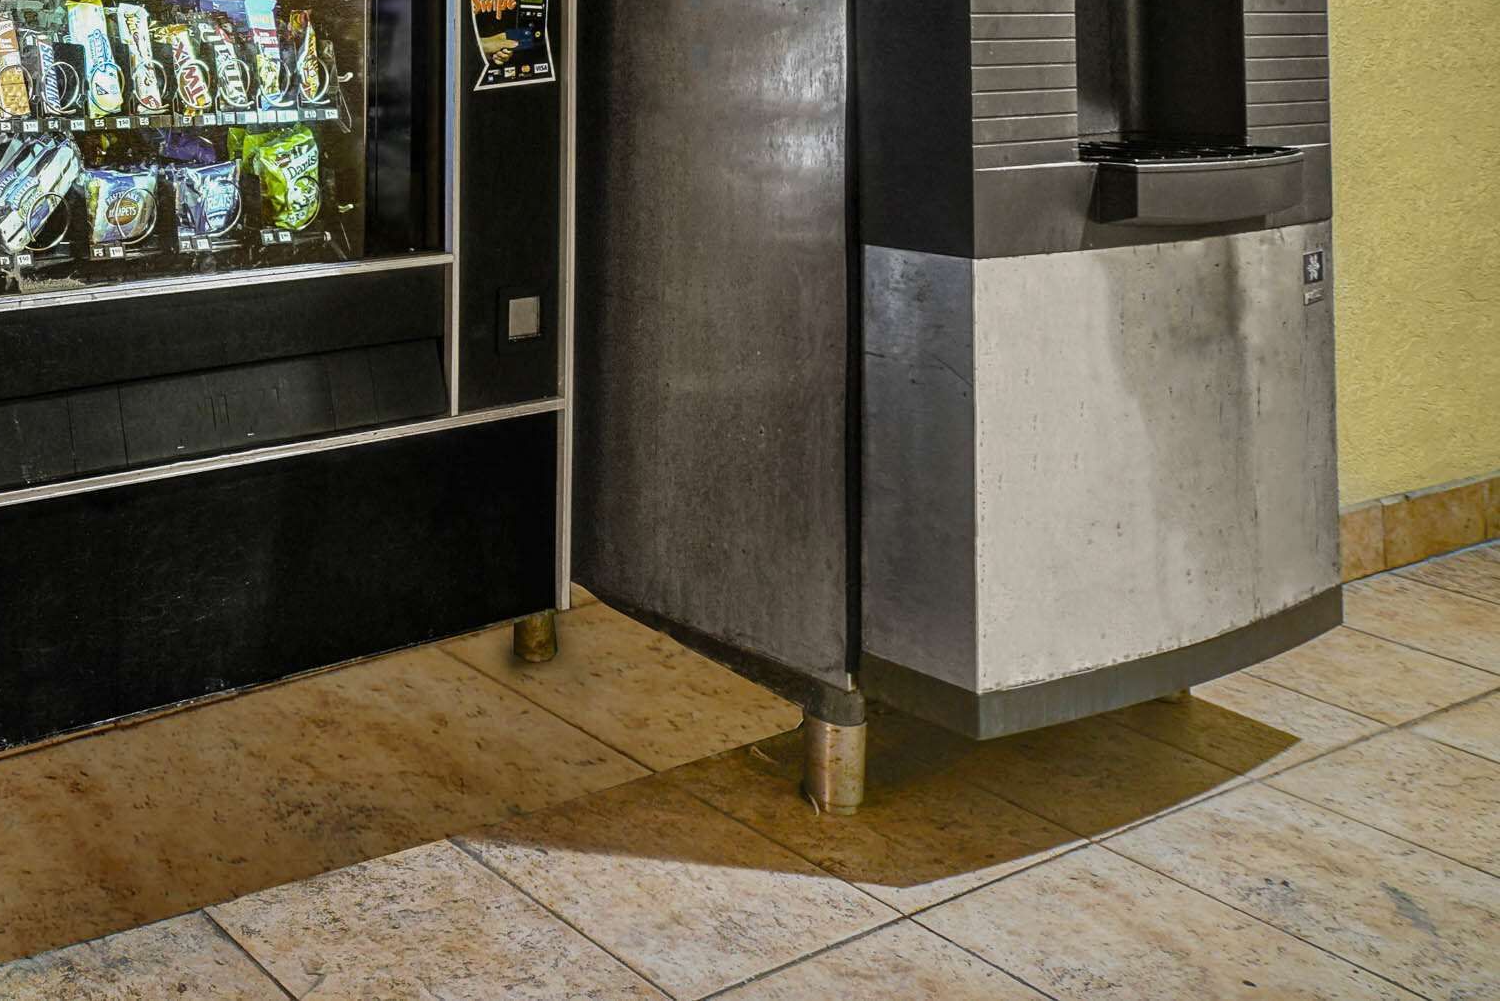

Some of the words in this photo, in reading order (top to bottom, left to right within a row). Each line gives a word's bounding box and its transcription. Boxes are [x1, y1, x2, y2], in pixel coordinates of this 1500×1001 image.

[49, 120, 59, 128] E4
[95, 118, 105, 127] E5
[140, 117, 150, 125] E6
